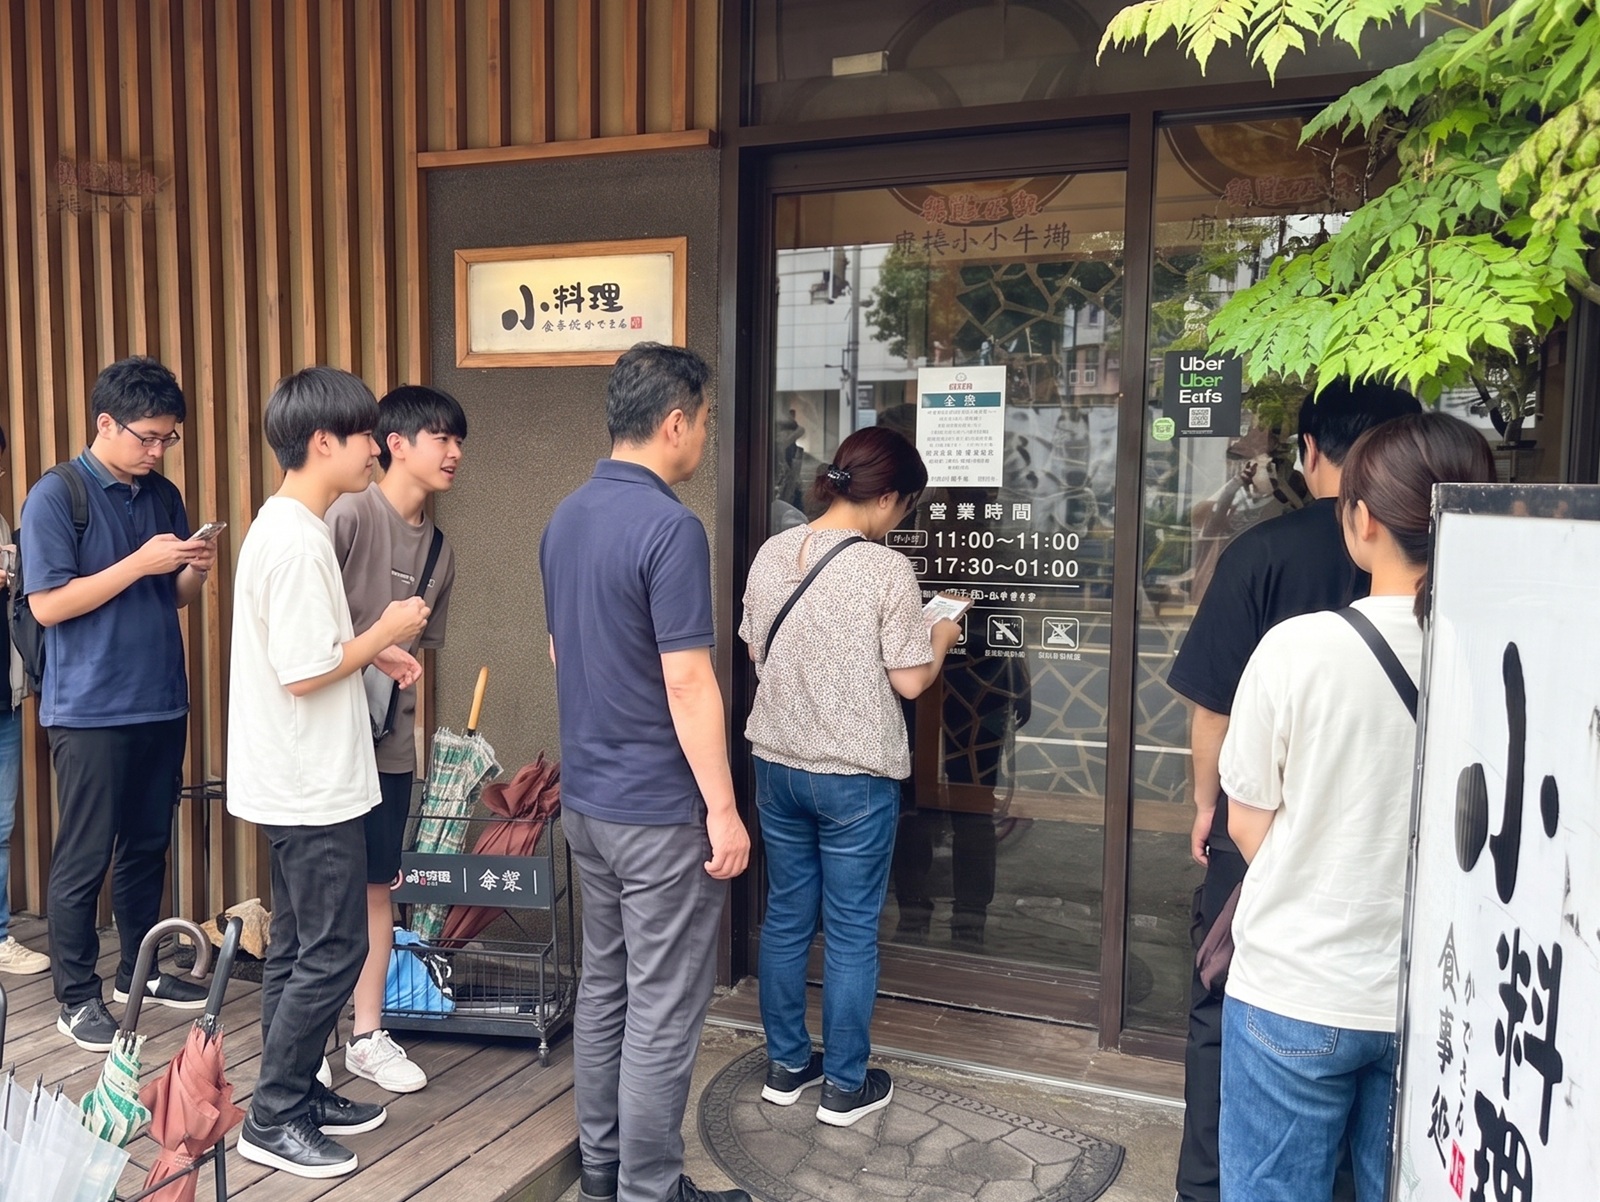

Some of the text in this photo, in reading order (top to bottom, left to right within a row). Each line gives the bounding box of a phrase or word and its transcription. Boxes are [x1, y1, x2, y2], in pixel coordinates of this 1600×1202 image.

[501, 281, 624, 331] 小料理
[1180, 356, 1225, 371] Uber
[1180, 373, 1223, 388] Uber
[929, 503, 1032, 521] 営業時間
